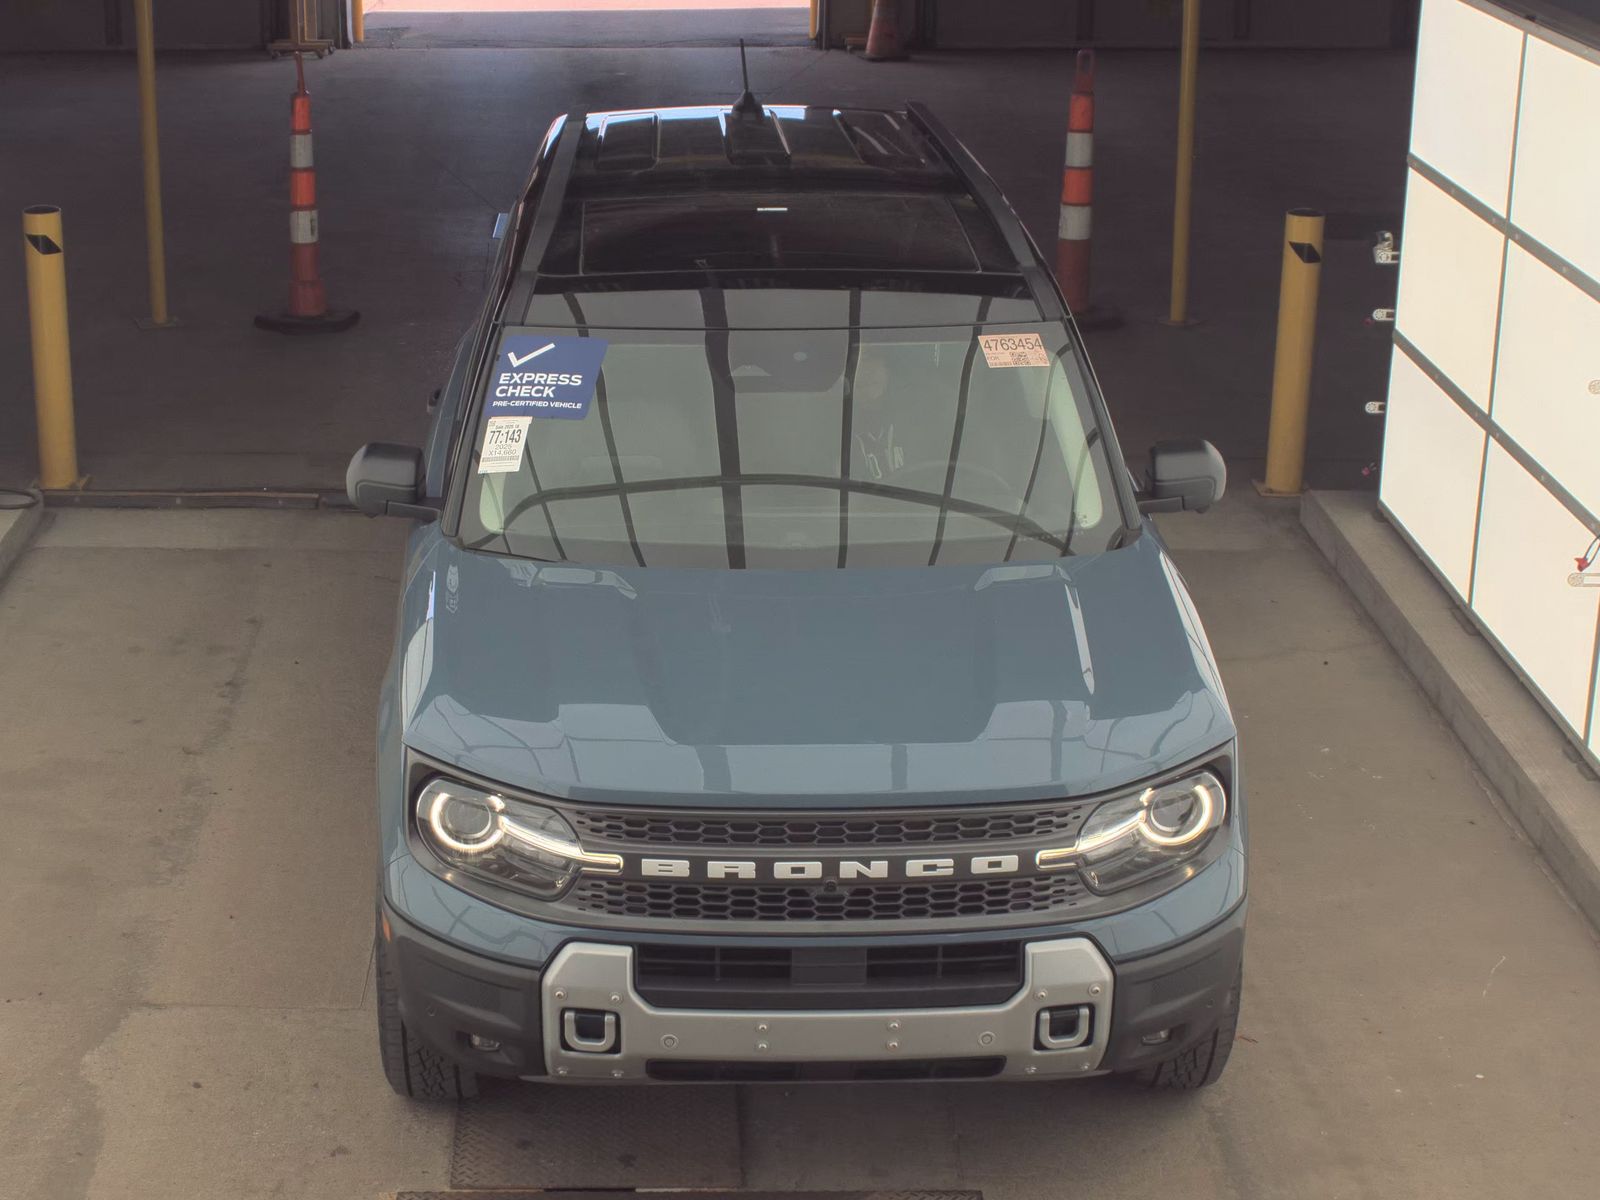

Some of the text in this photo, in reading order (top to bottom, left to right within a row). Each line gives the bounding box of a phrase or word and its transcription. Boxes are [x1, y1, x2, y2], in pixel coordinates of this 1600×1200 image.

[984, 337, 1042, 351] 4763454
[498, 372, 583, 386] EXPRESS
[495, 385, 556, 398] CHECK
[492, 400, 583, 409] PRE-CERTIFIED VEHICLE
[488, 429, 522, 445] 77:143
[640, 855, 1020, 880] BRONCO
